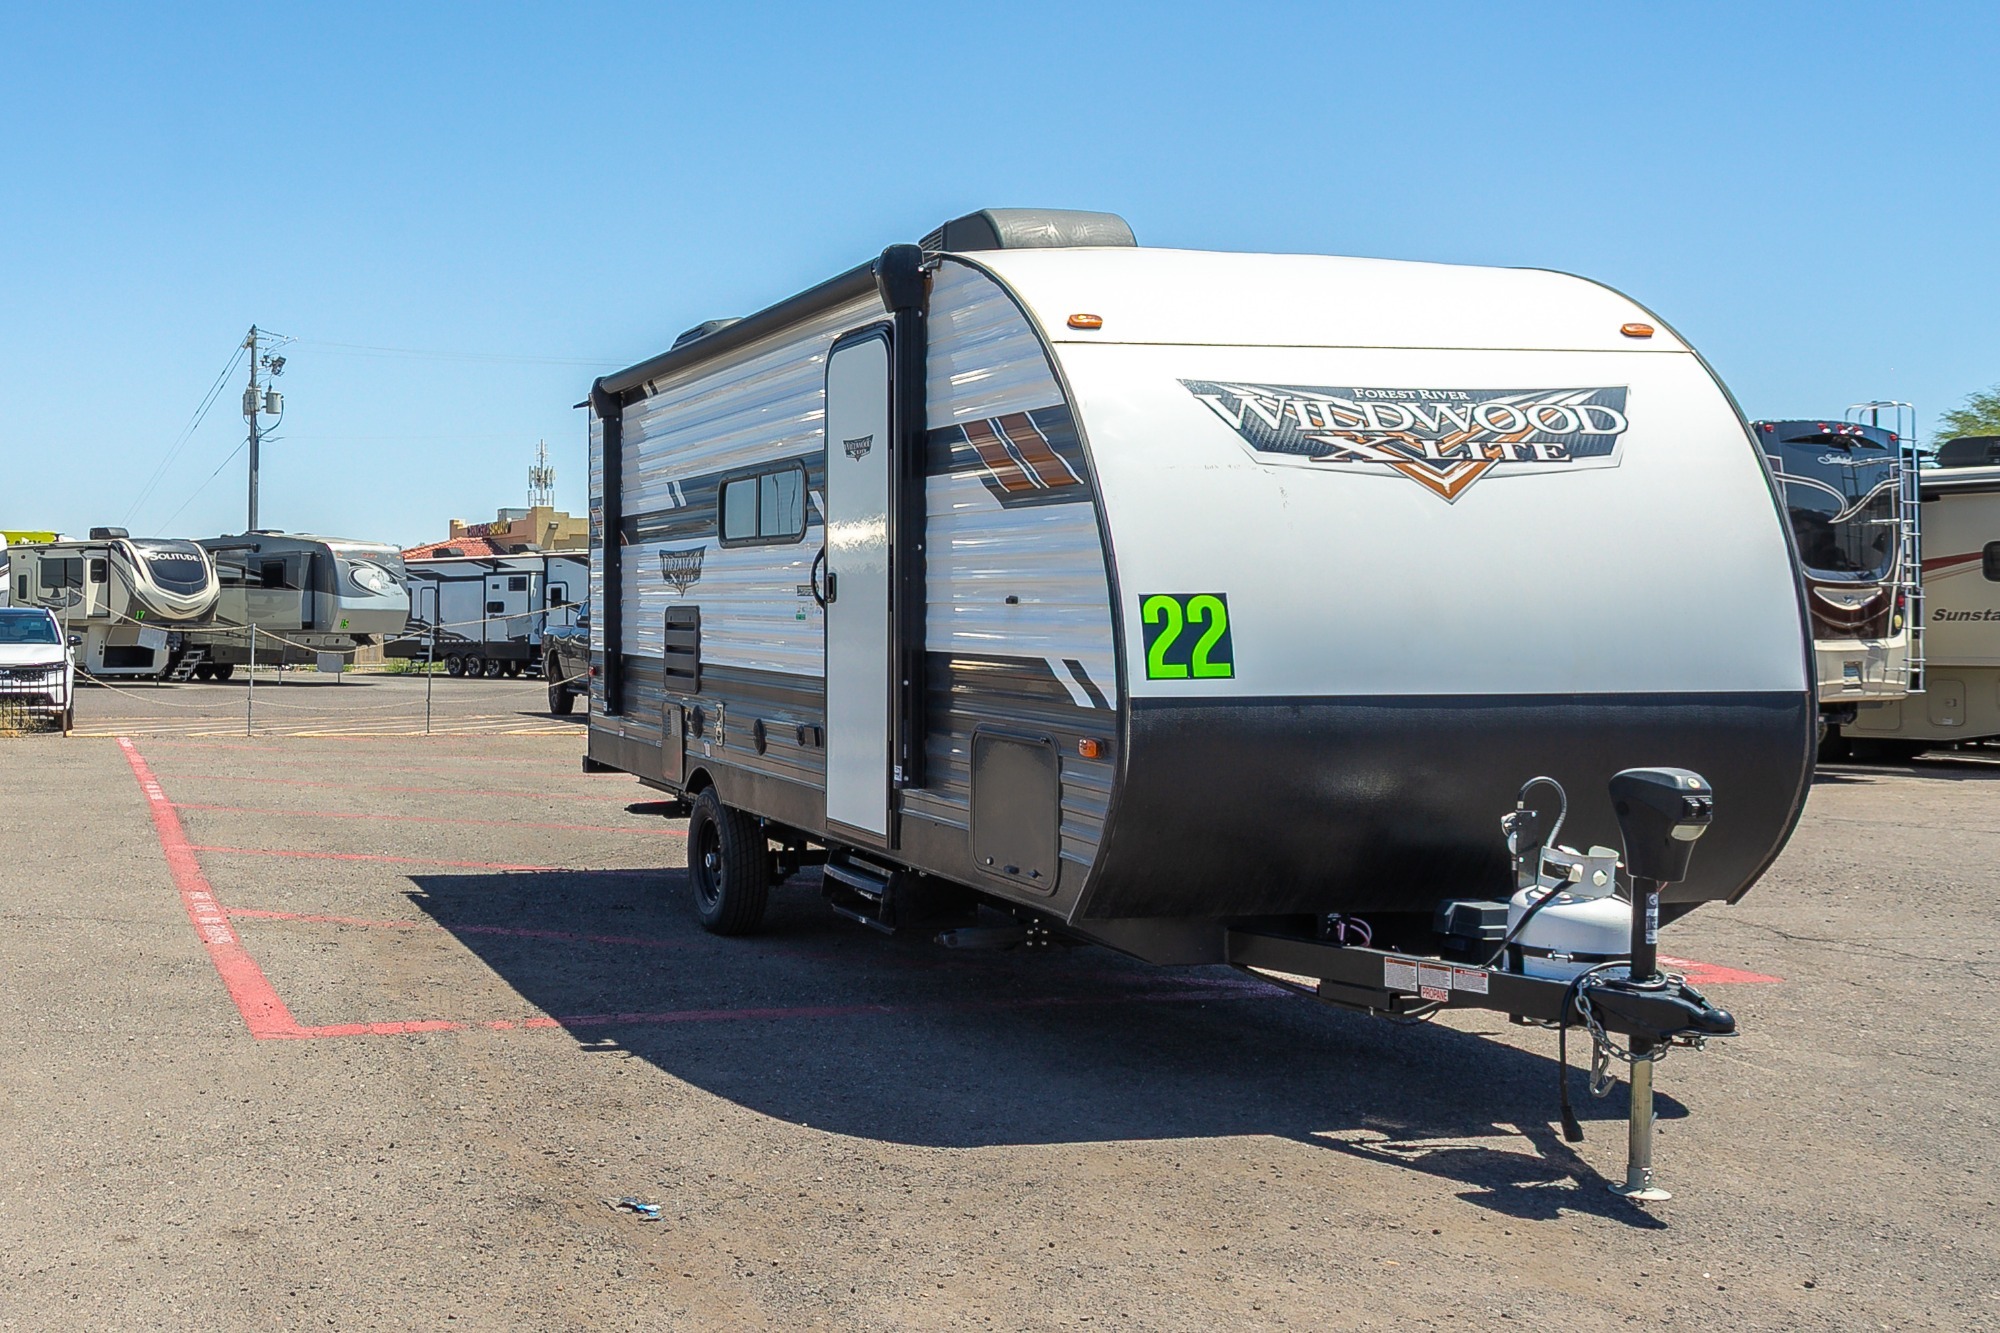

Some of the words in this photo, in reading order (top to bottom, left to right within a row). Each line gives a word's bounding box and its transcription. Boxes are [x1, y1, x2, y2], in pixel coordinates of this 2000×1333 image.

[1353, 388, 1416, 399] FOREST
[1418, 389, 1471, 400] RIVER
[1193, 393, 1629, 435] WILDWOOD
[150, 551, 201, 562] SOLITUDE
[135, 610, 146, 620] 17
[1932, 608, 2000, 621] Sunsta
[1142, 594, 1232, 679] 22
[1421, 986, 1448, 1002] PROPANE
